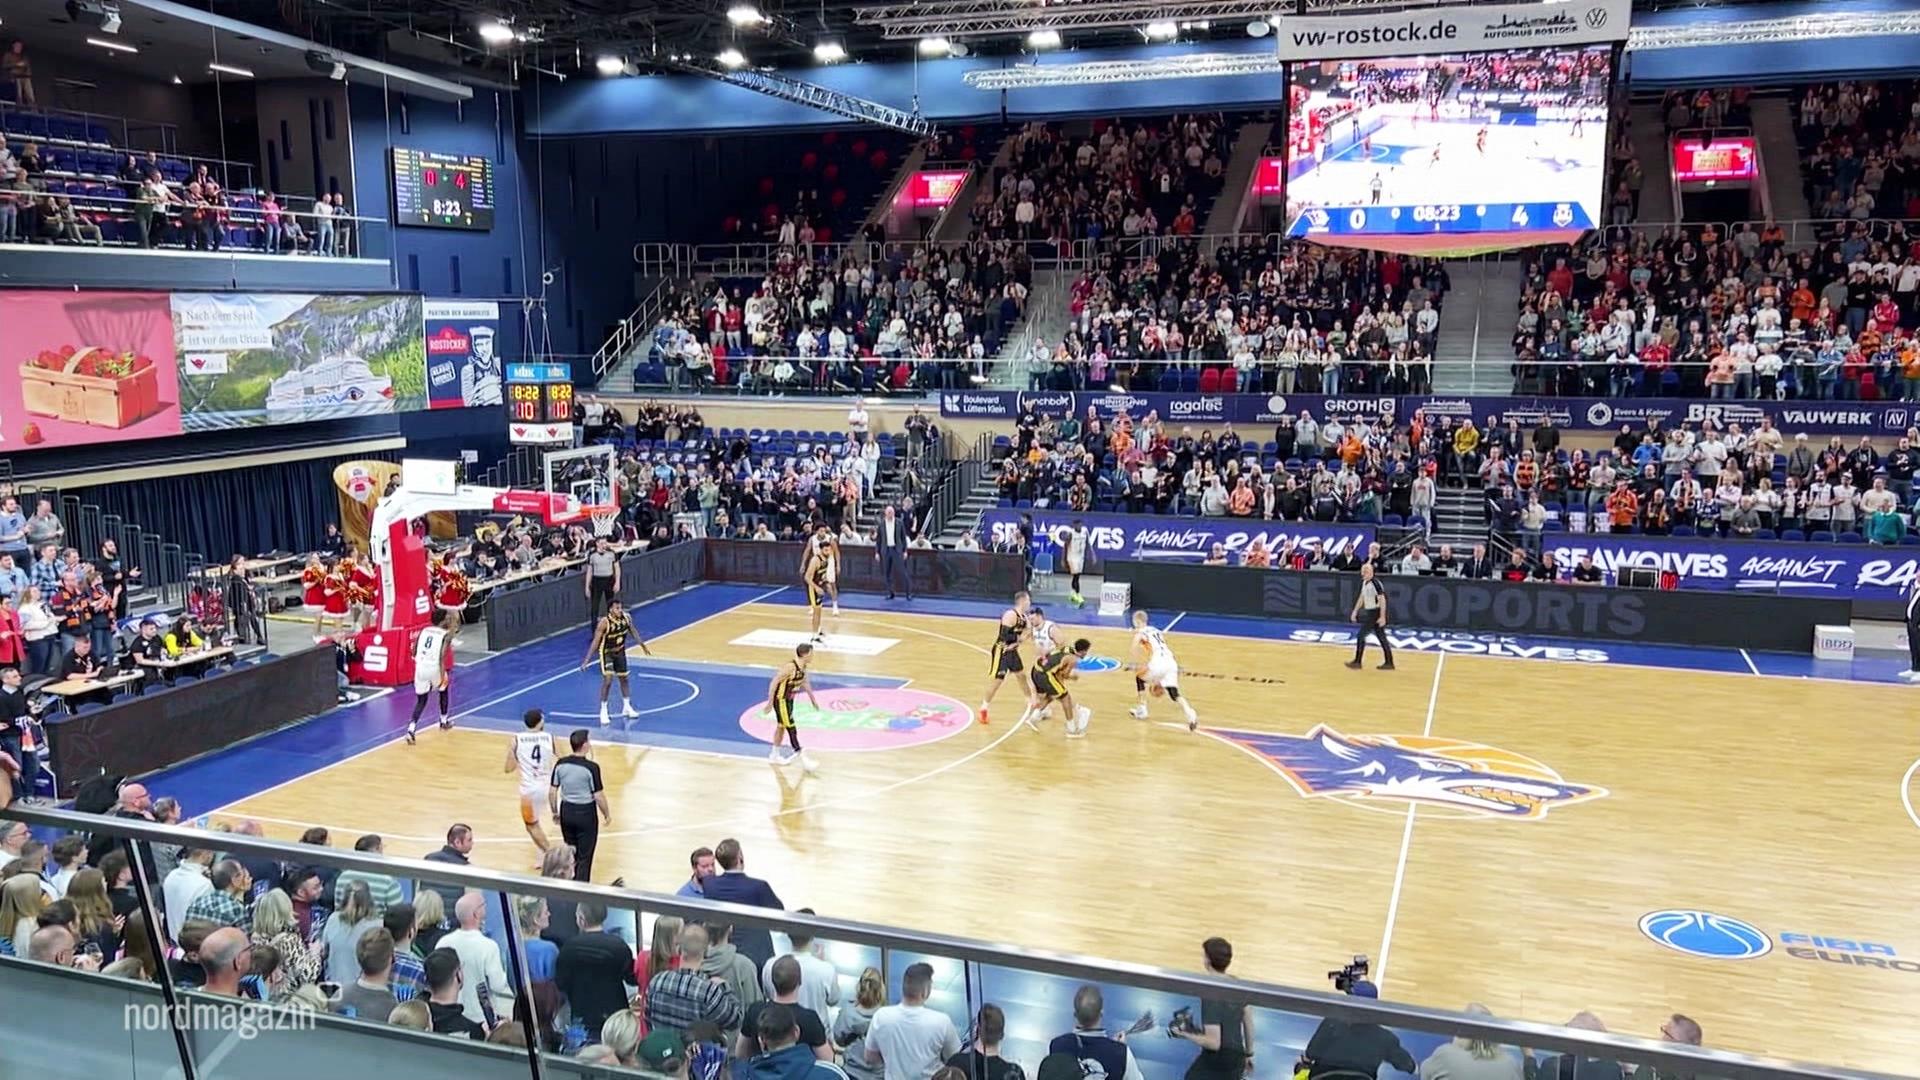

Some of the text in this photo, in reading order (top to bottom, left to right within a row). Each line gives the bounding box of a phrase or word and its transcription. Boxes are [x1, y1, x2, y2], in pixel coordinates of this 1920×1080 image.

[1293, 20, 1457, 46] vw-rostock.de
[1483, 25, 1578, 39] AUTOHAUS ROSTOCK
[424, 169, 466, 189] 0 4
[433, 199, 461, 217] 8:23
[1350, 208, 1366, 229] 0
[1413, 205, 1461, 222] 08:23
[1511, 206, 1529, 226] 4
[515, 385, 540, 400] 8:22
[551, 384, 572, 399] 8:22
[963, 395, 1000, 404] Boulevard
[518, 401, 534, 420] 10
[554, 401, 568, 419] 10
[987, 405, 1006, 414] Klein
[1324, 399, 1377, 412] GROTH
[1614, 408, 1636, 416] Evers
[1688, 403, 1724, 431] BR
[1783, 410, 1873, 426] VAUWERK
[1134, 528, 1214, 549] AGAINST
[1739, 555, 1847, 582] AGAINST
[424, 636, 433, 648] 8
[531, 744, 541, 763] 4
[1779, 931, 1896, 957] FIBA
